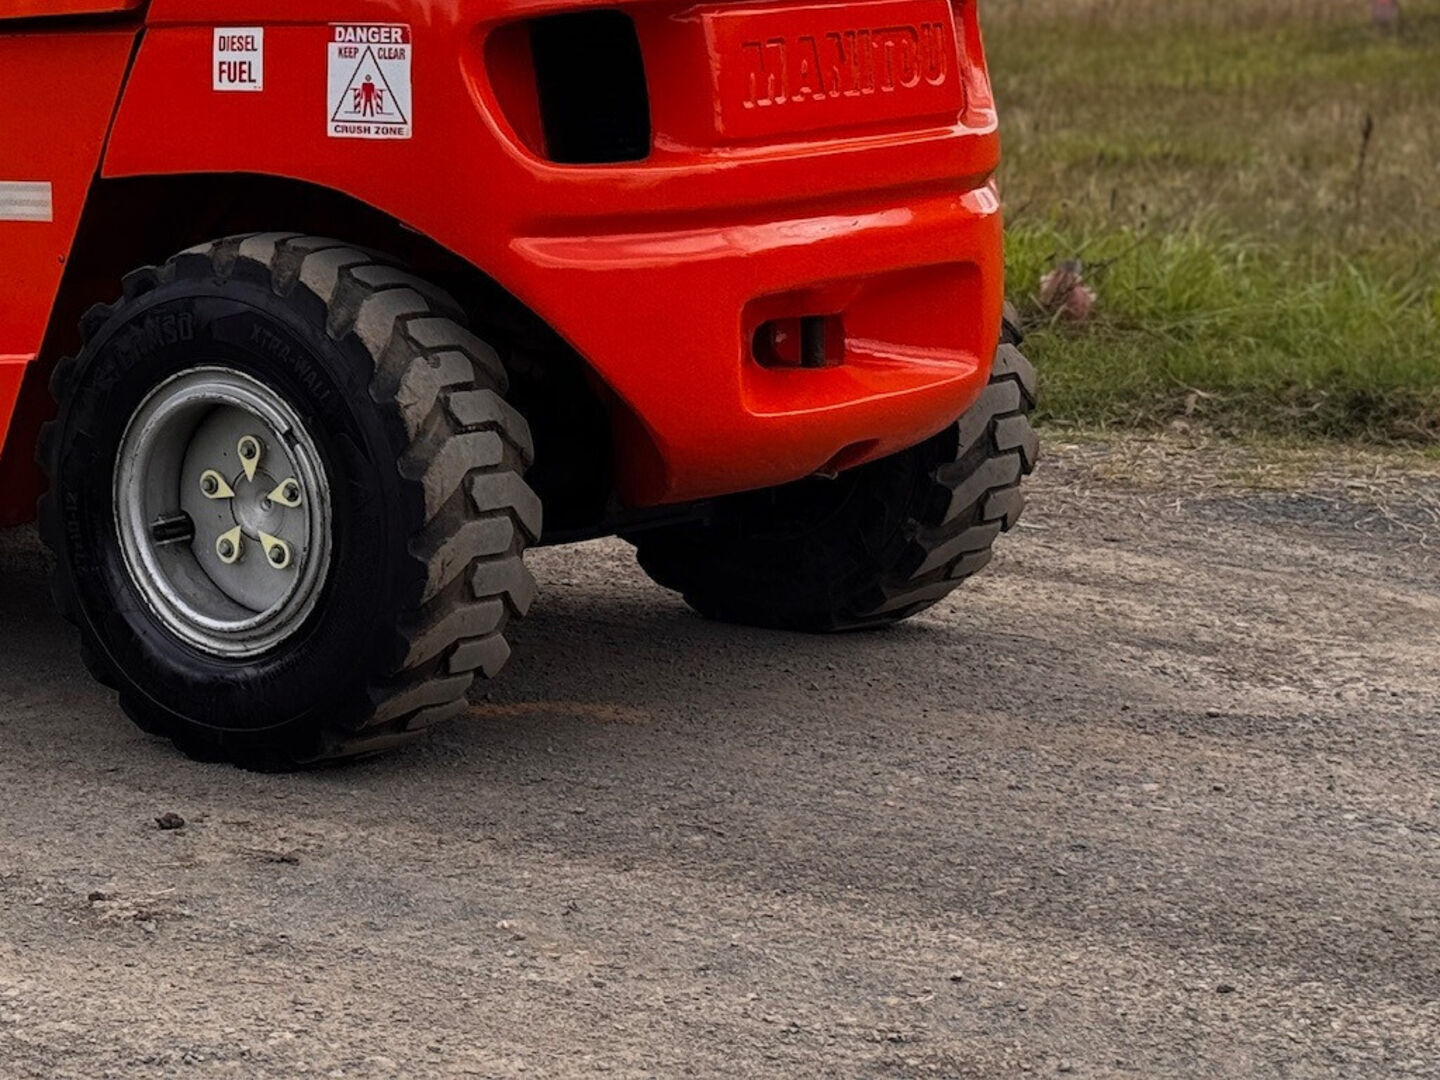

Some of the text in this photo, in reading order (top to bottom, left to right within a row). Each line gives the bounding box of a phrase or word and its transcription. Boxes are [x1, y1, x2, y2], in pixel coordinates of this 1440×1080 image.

[334, 27, 402, 43] DANGER
[218, 35, 258, 52] DIESEL
[338, 47, 406, 60] KEEP CLEAR
[218, 61, 257, 84] FUEL
[742, 22, 948, 109] MANITOU
[333, 124, 405, 137] CRUSH ZONE
